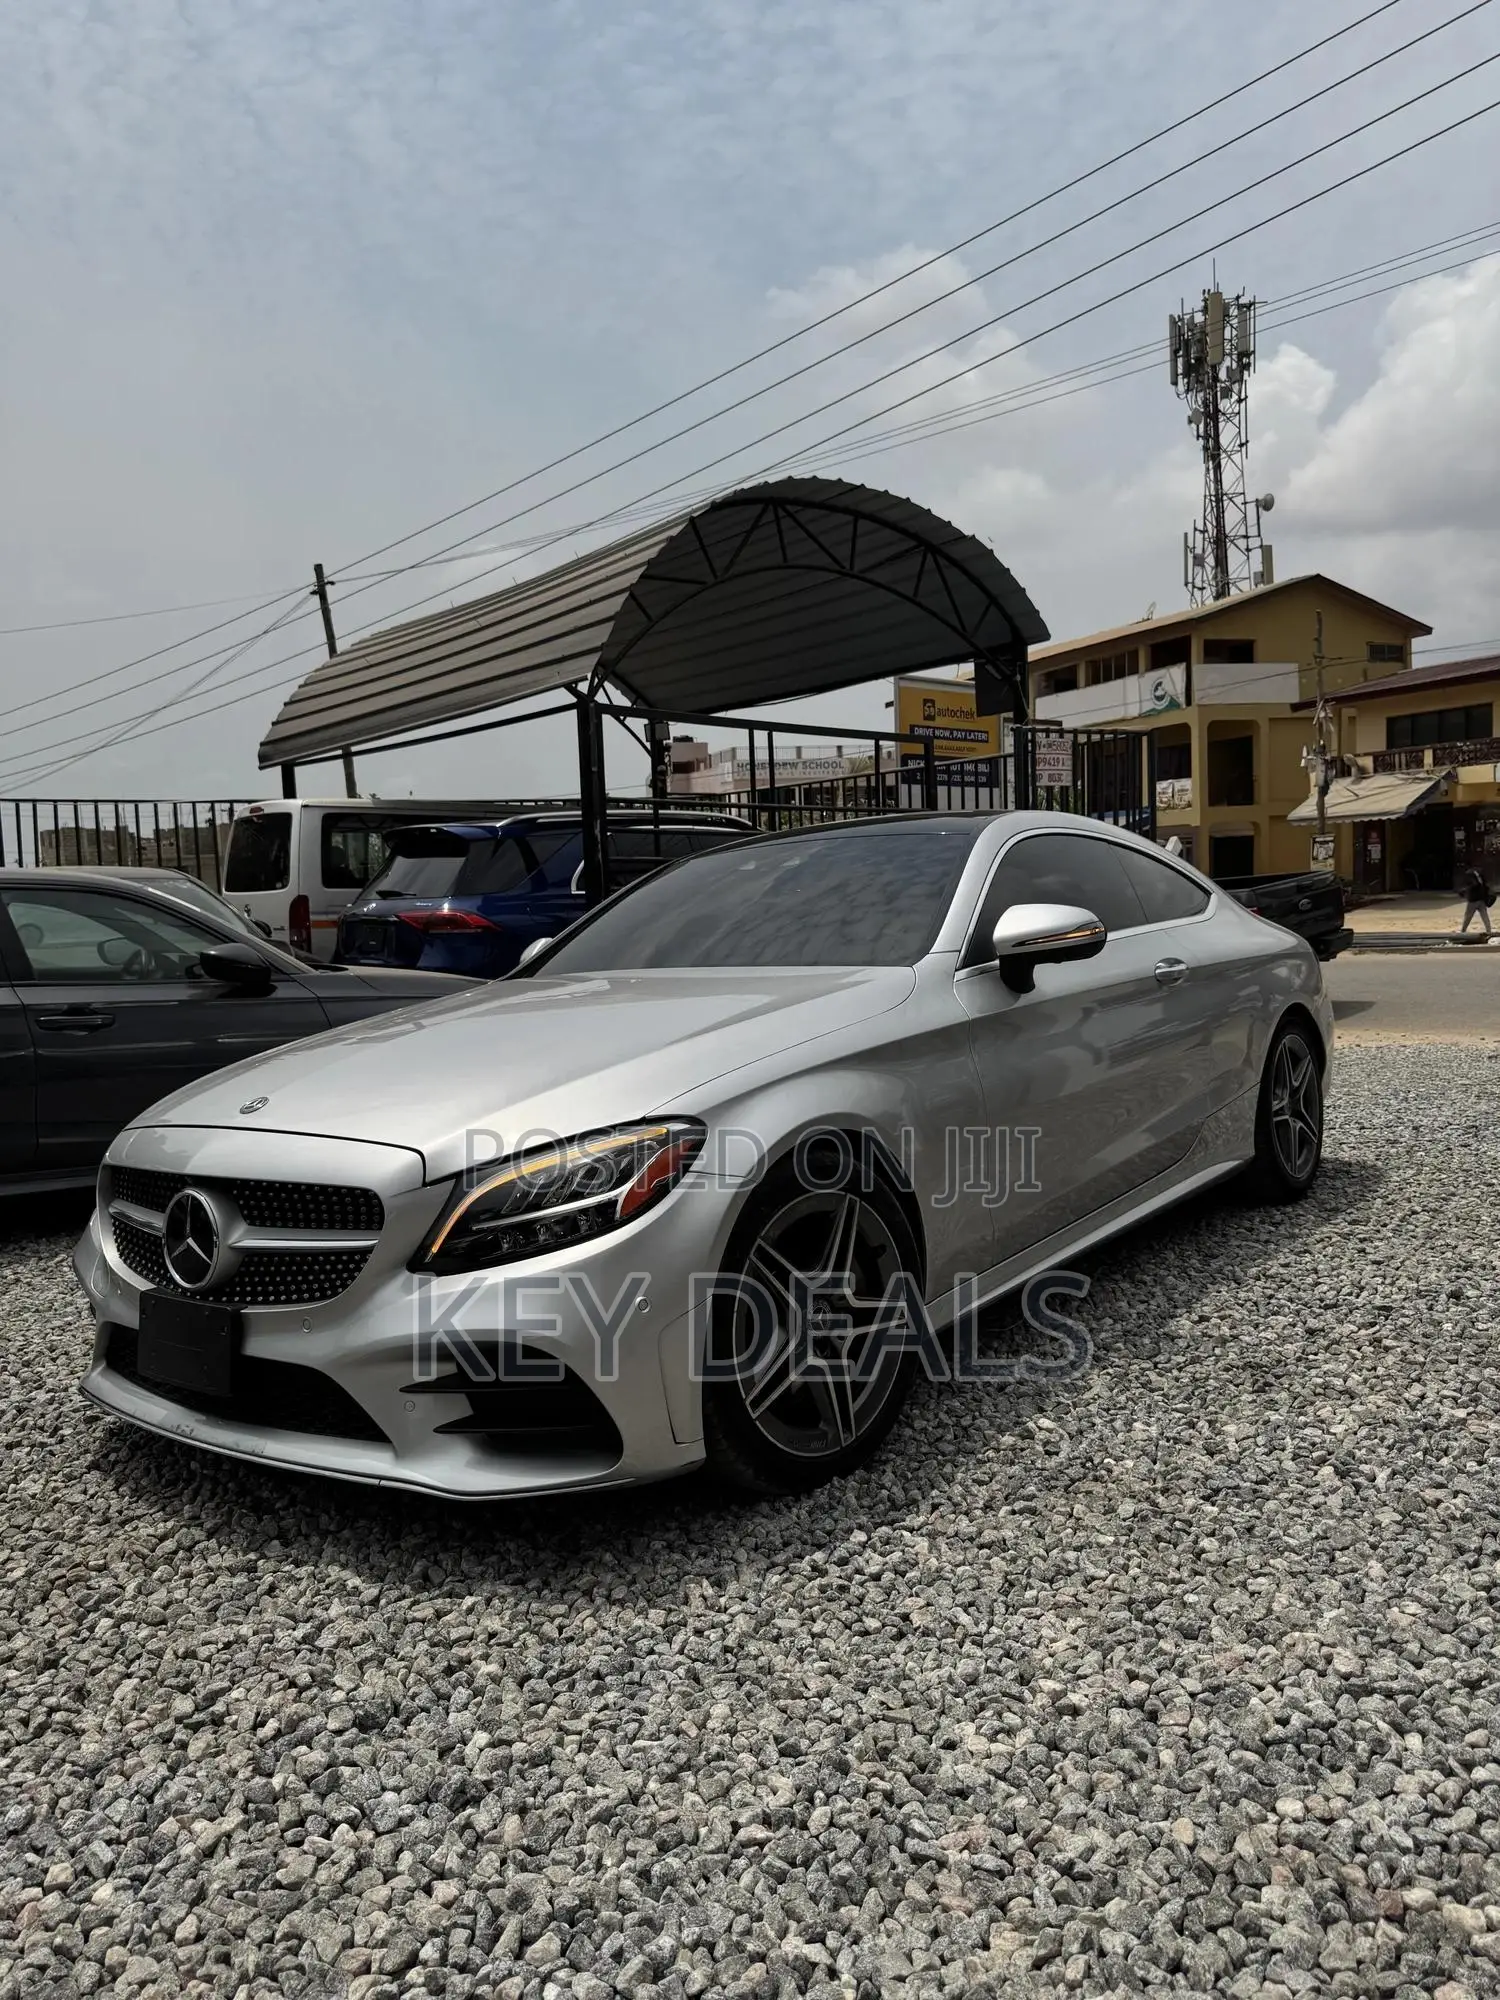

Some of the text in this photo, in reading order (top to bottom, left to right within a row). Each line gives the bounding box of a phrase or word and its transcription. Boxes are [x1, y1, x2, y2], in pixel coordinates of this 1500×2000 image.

[936, 704, 976, 720] autochek
[914, 727, 934, 736] DRIVE
[953, 731, 965, 740] PAY
[802, 760, 844, 770] SCHOOL
